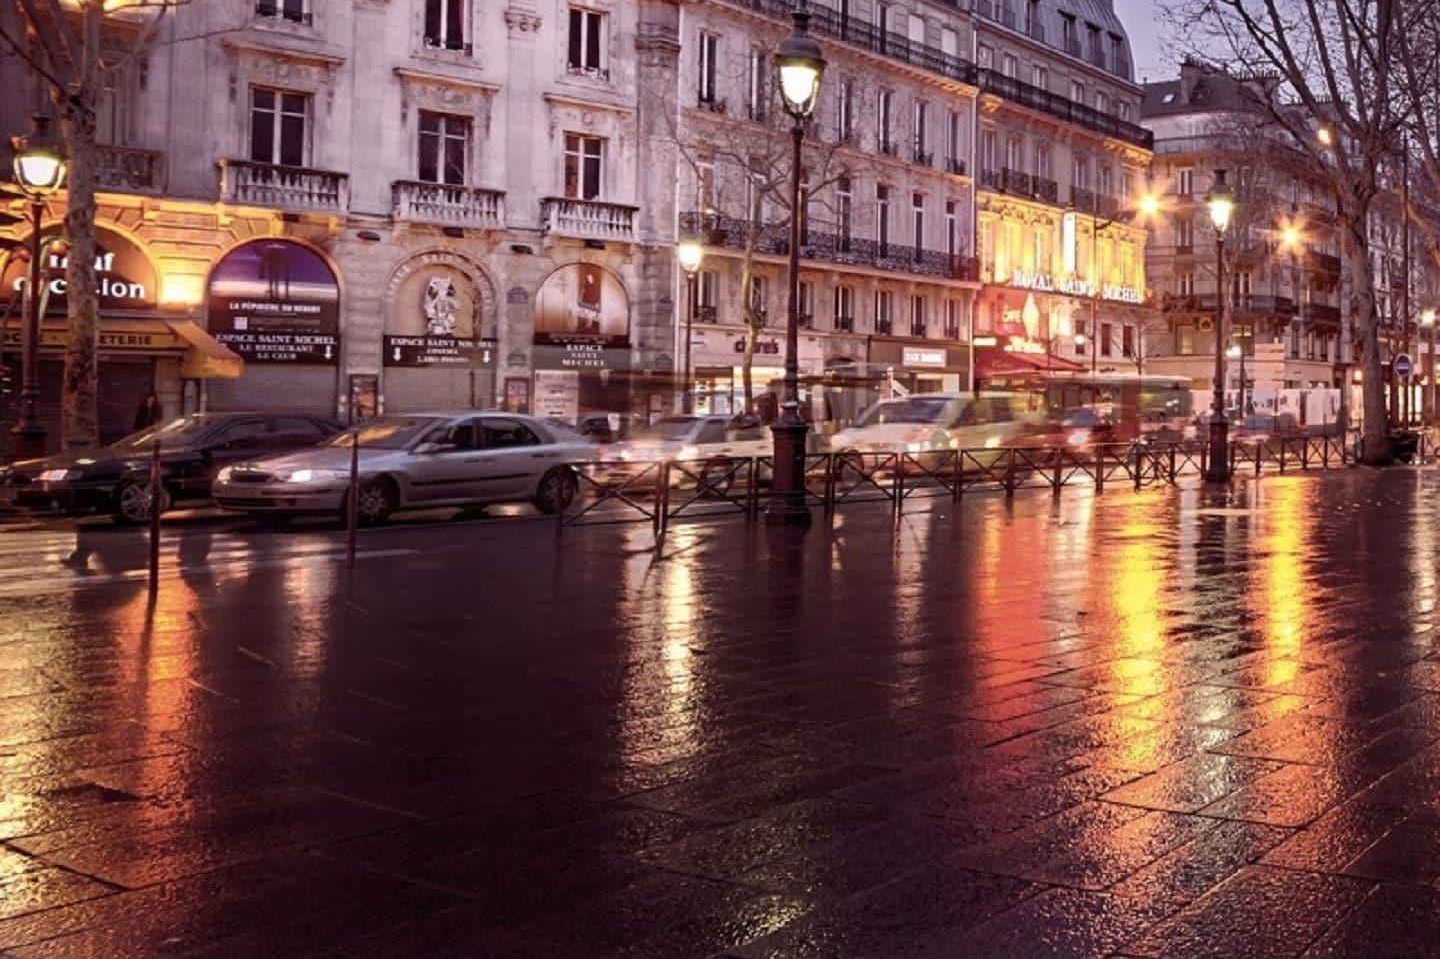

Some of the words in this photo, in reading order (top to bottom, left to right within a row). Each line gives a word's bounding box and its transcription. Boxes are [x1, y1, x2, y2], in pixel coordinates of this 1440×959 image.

[1012, 270, 1054, 292] ROYAL
[258, 334, 291, 344] SAINT
[294, 335, 337, 345] MICHEL
[427, 339, 456, 348] SAINT
[566, 344, 603, 352] ESPACE
